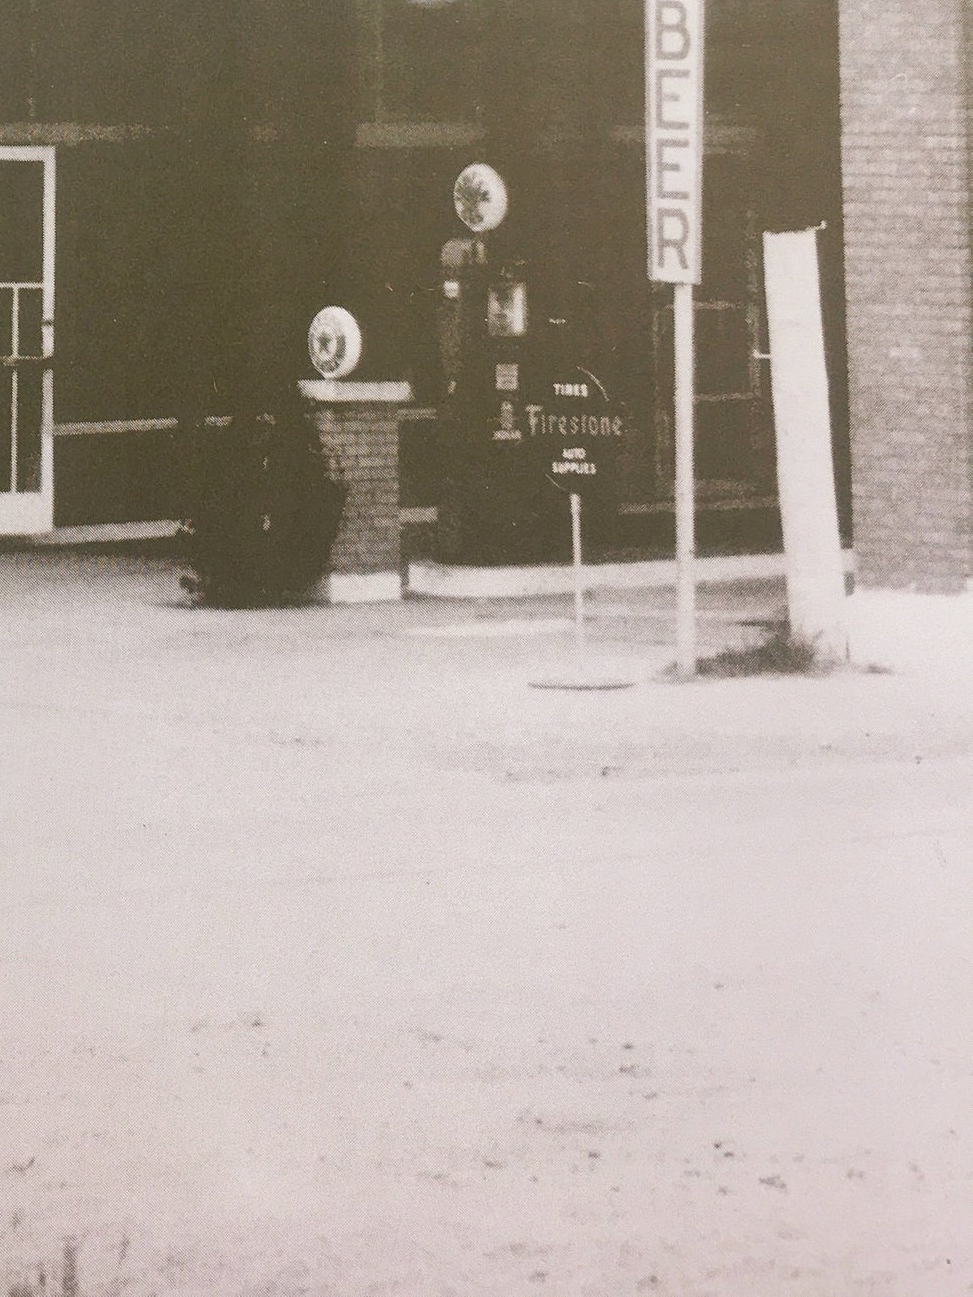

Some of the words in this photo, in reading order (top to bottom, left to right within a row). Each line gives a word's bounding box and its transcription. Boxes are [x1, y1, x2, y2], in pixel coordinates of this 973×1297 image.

[654, 0, 692, 270] BEER
[553, 383, 589, 397] TIRES
[525, 404, 624, 437] Firestone
[562, 447, 587, 460] AUTO
[551, 461, 598, 475] SUPPLIES
